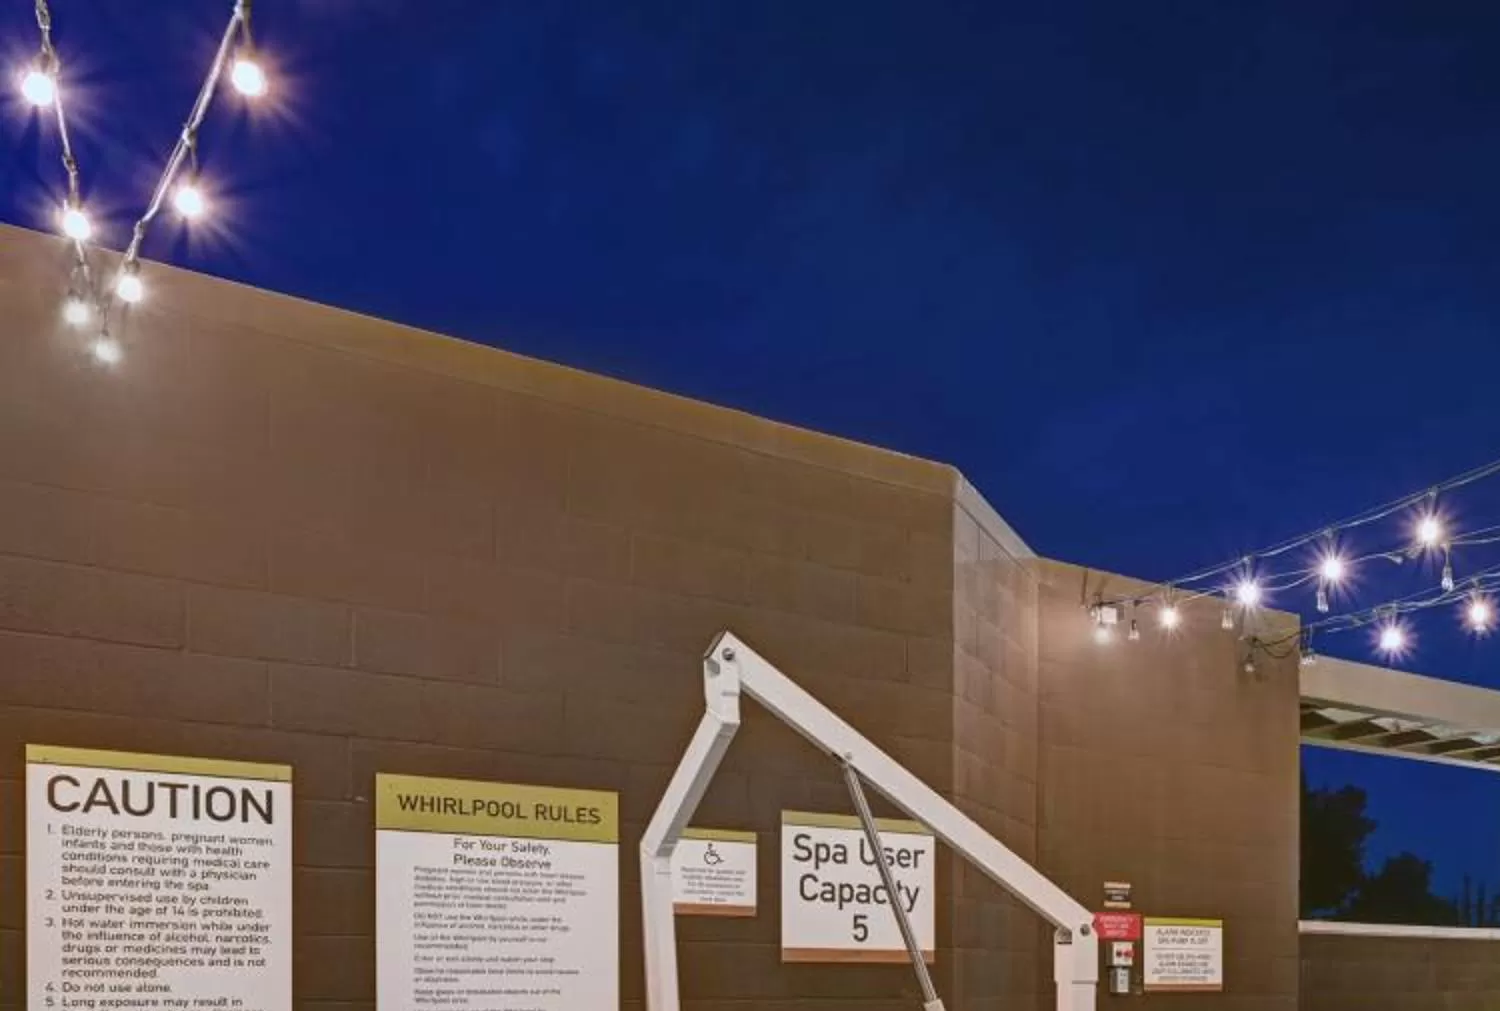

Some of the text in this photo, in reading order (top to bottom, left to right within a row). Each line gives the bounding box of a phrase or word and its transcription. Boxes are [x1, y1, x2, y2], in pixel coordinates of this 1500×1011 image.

[47, 774, 274, 825] CAUTION
[397, 793, 602, 825] WHIRLPOOL RULES
[61, 824, 108, 839] Elderly
[171, 832, 225, 846] pregnant
[61, 838, 243, 857] infants and those with health
[453, 838, 477, 850] For
[479, 839, 509, 851] Your
[793, 833, 925, 869] Spa User
[61, 851, 271, 869] conditions requiring medical care
[453, 853, 552, 869] Please Observe
[61, 864, 257, 882] should consult with a physician
[61, 875, 106, 887] before
[107, 877, 161, 891] entering
[164, 878, 185, 889] the
[61, 889, 153, 903] Unsupervised
[155, 894, 180, 904] use
[183, 893, 197, 907] by
[199, 895, 249, 906] children
[799, 873, 919, 912] Capacy
[61, 904, 101, 914] under
[104, 904, 125, 915] the
[128, 906, 150, 916] age
[155, 906, 168, 916] of
[172, 906, 185, 916] 14
[187, 906, 199, 917] is
[61, 918, 85, 928] Hot
[89, 920, 125, 929] water
[129, 919, 197, 931] immersion
[201, 921, 234, 932] while
[236, 922, 272, 933] under
[852, 914, 868, 942] 5
[61, 930, 82, 941] the
[87, 930, 145, 941] influence
[149, 931, 162, 942] of
[61, 943, 261, 956] drugs or medicines may lead to
[61, 956, 266, 968] serious consequences and is not
[62, 981, 81, 993] Do
[84, 982, 105, 993] not
[109, 984, 133, 993] use
[135, 981, 173, 993] alone.
[62, 997, 95, 1009] Long
[99, 999, 159, 1009] exposure
[163, 999, 189, 1010] may
[193, 997, 228, 1007] result
[231, 997, 244, 1007] in
